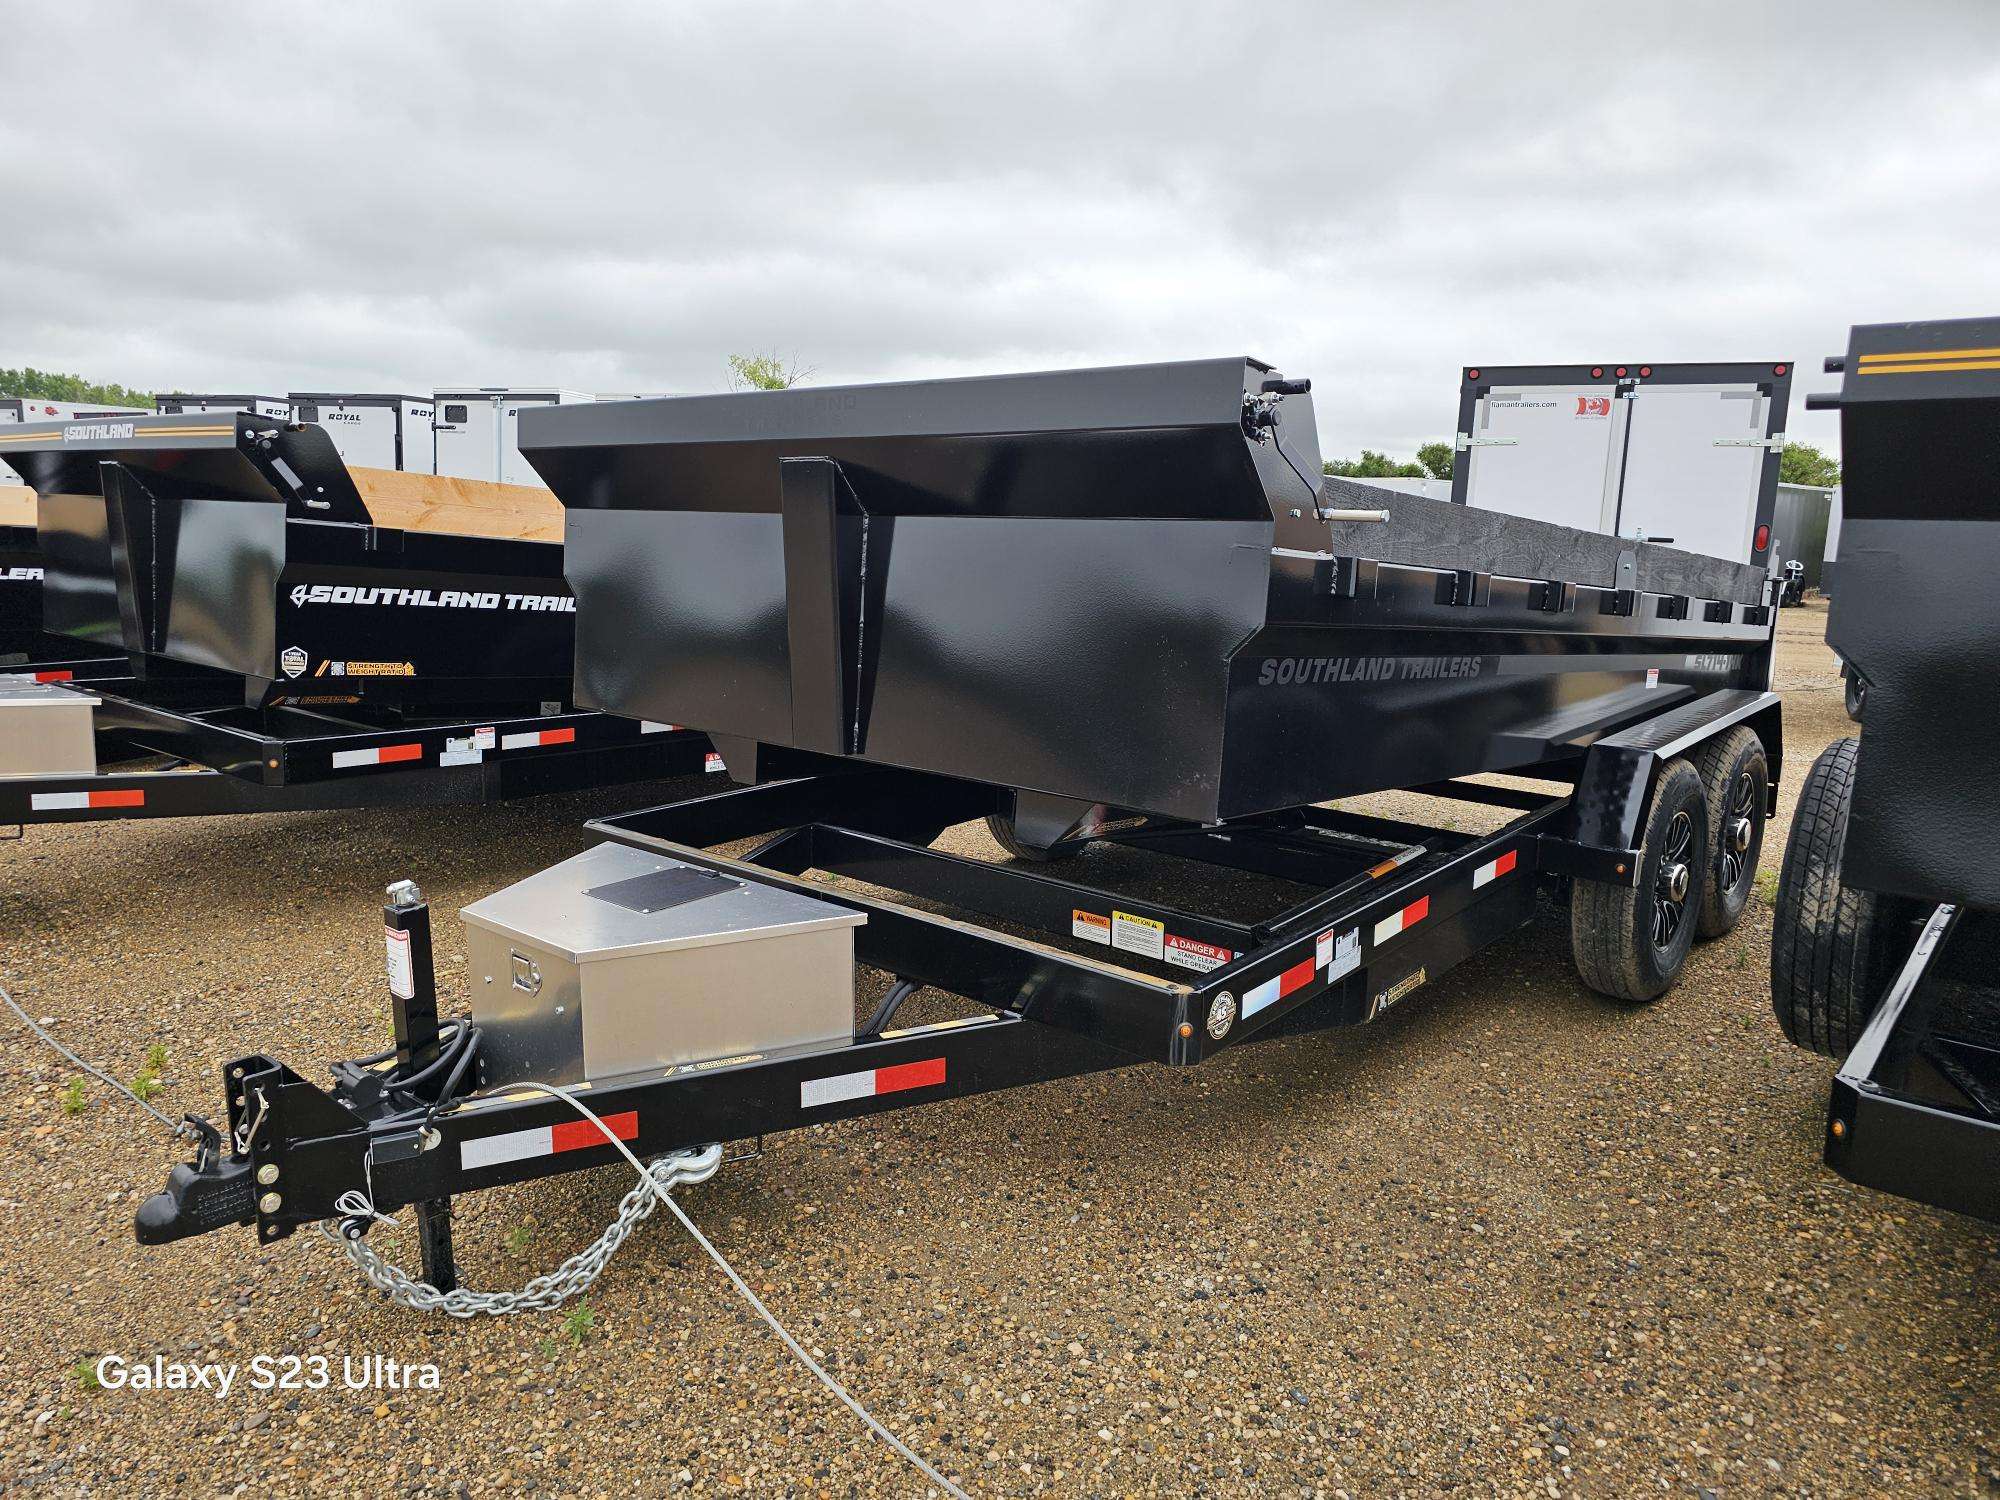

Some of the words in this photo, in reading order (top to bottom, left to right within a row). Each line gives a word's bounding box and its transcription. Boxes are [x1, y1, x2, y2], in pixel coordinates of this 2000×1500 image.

[328, 413, 362, 421] ROYAL
[67, 423, 134, 440] SOUTHLAND
[307, 585, 501, 609] SOUTHLAND
[1258, 657, 1396, 686] SOUTHLAND
[1399, 656, 1482, 680] TRAILERS
[1125, 915, 1151, 928] CAUTION
[1179, 940, 1215, 957] DANGER
[1170, 955, 1189, 966] WHILE
[1177, 951, 1197, 961] STAND
[1197, 956, 1218, 966] CLEAR
